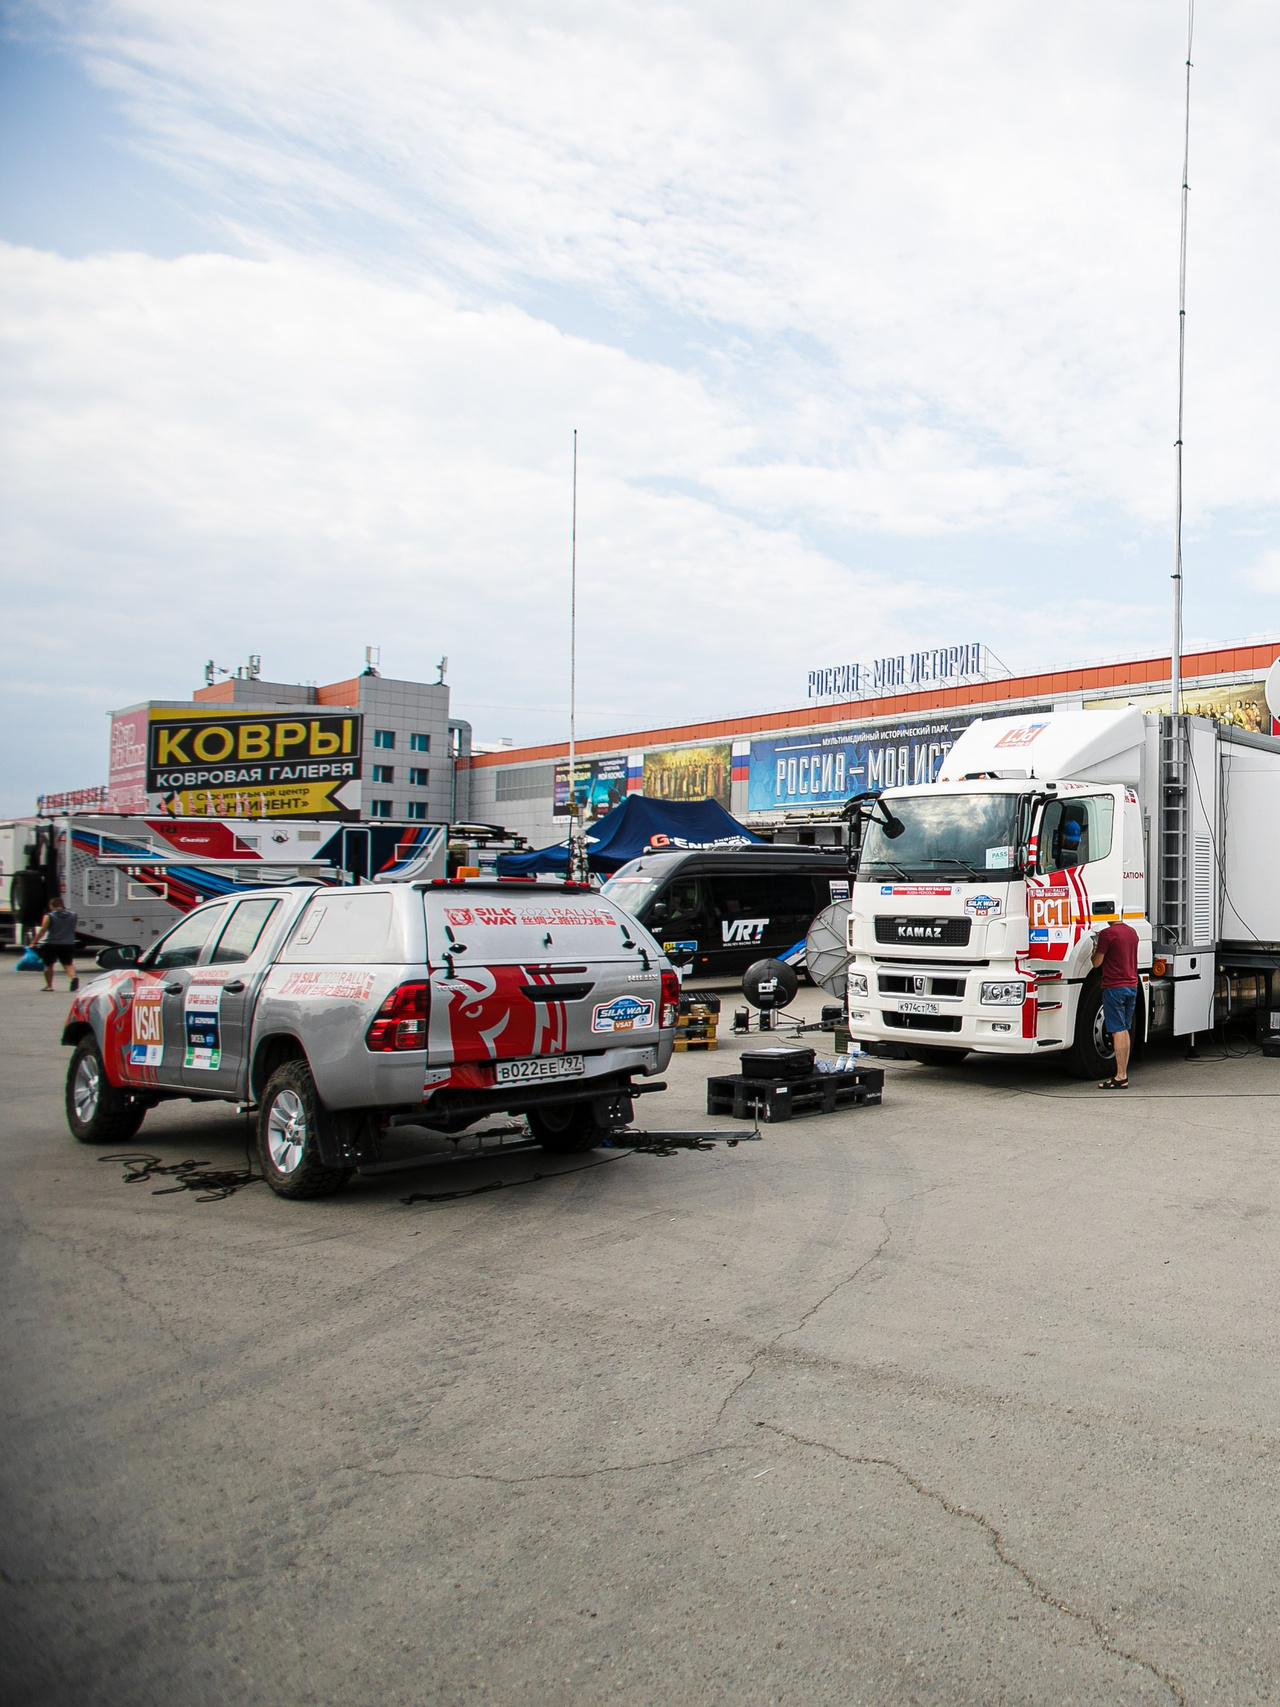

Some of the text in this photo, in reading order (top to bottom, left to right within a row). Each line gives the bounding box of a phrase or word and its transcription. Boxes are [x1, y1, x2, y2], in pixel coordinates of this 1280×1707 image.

[808, 663, 859, 698] РОССИЯ
[873, 655, 904, 689] МОЯ
[910, 642, 981, 684] ИСТОРИЯ
[821, 722, 949, 747] МУЛЬТИМЕДИЙНЫЙ ИСТОРИЧЕСКИЙ ПАРК
[158, 719, 353, 765] КОВРЫ
[156, 768, 262, 787] КОВРОВАЯ
[269, 762, 354, 781] ГАЛЕРЕЯ
[776, 752, 846, 797] РОССИЯ
[867, 745, 910, 790] МОЯ
[914, 741, 957, 785] ИСТ
[278, 787, 310, 797] центр
[991, 850, 1008, 859] PASS
[1123, 871, 1144, 879] ZATION
[474, 907, 600, 917] SILK 2021 RALLY
[1033, 898, 1063, 928] PC1
[479, 916, 518, 926] WAY
[722, 918, 770, 943] VRT
[898, 926, 942, 938] KAMAZ
[300, 972, 322, 983] SILK
[340, 972, 370, 985] RALLY
[627, 973, 659, 983] HILUX
[292, 984, 314, 995] WAY
[436, 983, 470, 992] TOYOTA
[600, 1008, 626, 1018] SILK
[626, 1005, 649, 1015] WAY
[135, 1005, 161, 1041] VSAT
[615, 1020, 633, 1028] VSAT
[500, 1055, 580, 1080] В022ЕЕ 797
